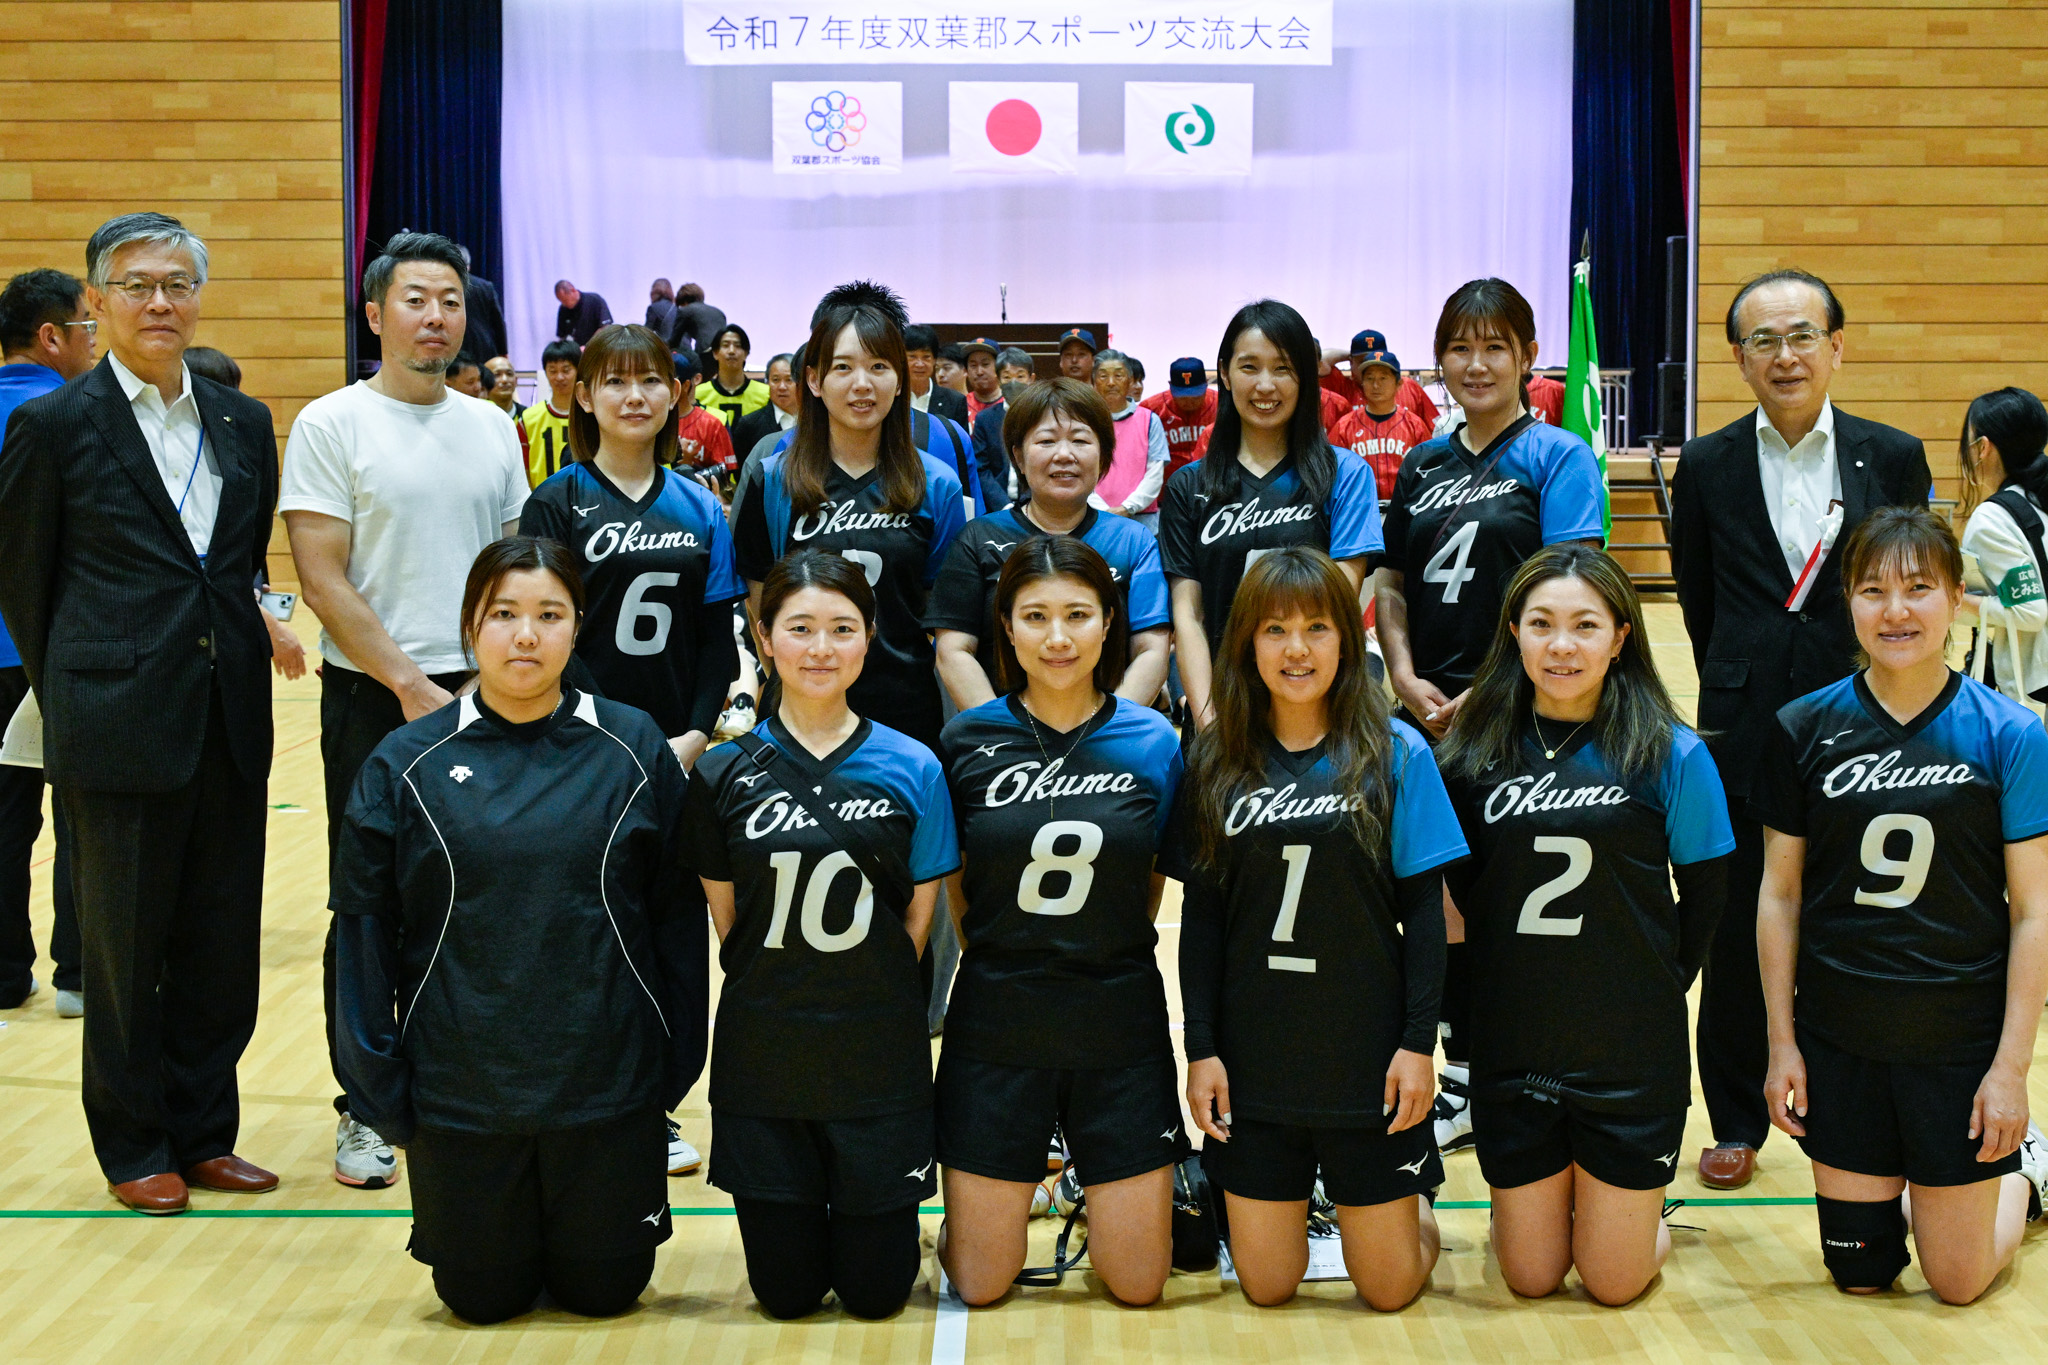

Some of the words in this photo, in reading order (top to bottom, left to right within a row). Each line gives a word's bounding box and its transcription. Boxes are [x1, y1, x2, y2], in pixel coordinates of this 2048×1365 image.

[791, 155, 881, 166] 双葉郡スポーツ協会
[1071, 328, 1080, 337] T
[1365, 337, 1375, 348] T
[1374, 352, 1384, 361] T
[1182, 372, 1192, 385] T
[542, 425, 569, 478] 1
[793, 499, 912, 541] Okuma
[1201, 497, 1317, 545] Okuma
[1409, 474, 1519, 516] Okuma
[584, 520, 698, 563] Okuma
[1423, 521, 1479, 603] 4
[615, 572, 680, 656] 6
[985, 757, 1138, 808] Okuma
[1483, 771, 1630, 824] Okuma
[1822, 750, 1975, 798] Okuma
[744, 785, 894, 840] Okma
[1225, 783, 1364, 837] Okuma
[1017, 820, 1103, 915] 8
[1516, 836, 1593, 936] 2
[1854, 813, 1935, 908] 9
[764, 850, 874, 952] 10
[1271, 844, 1311, 942] 1
